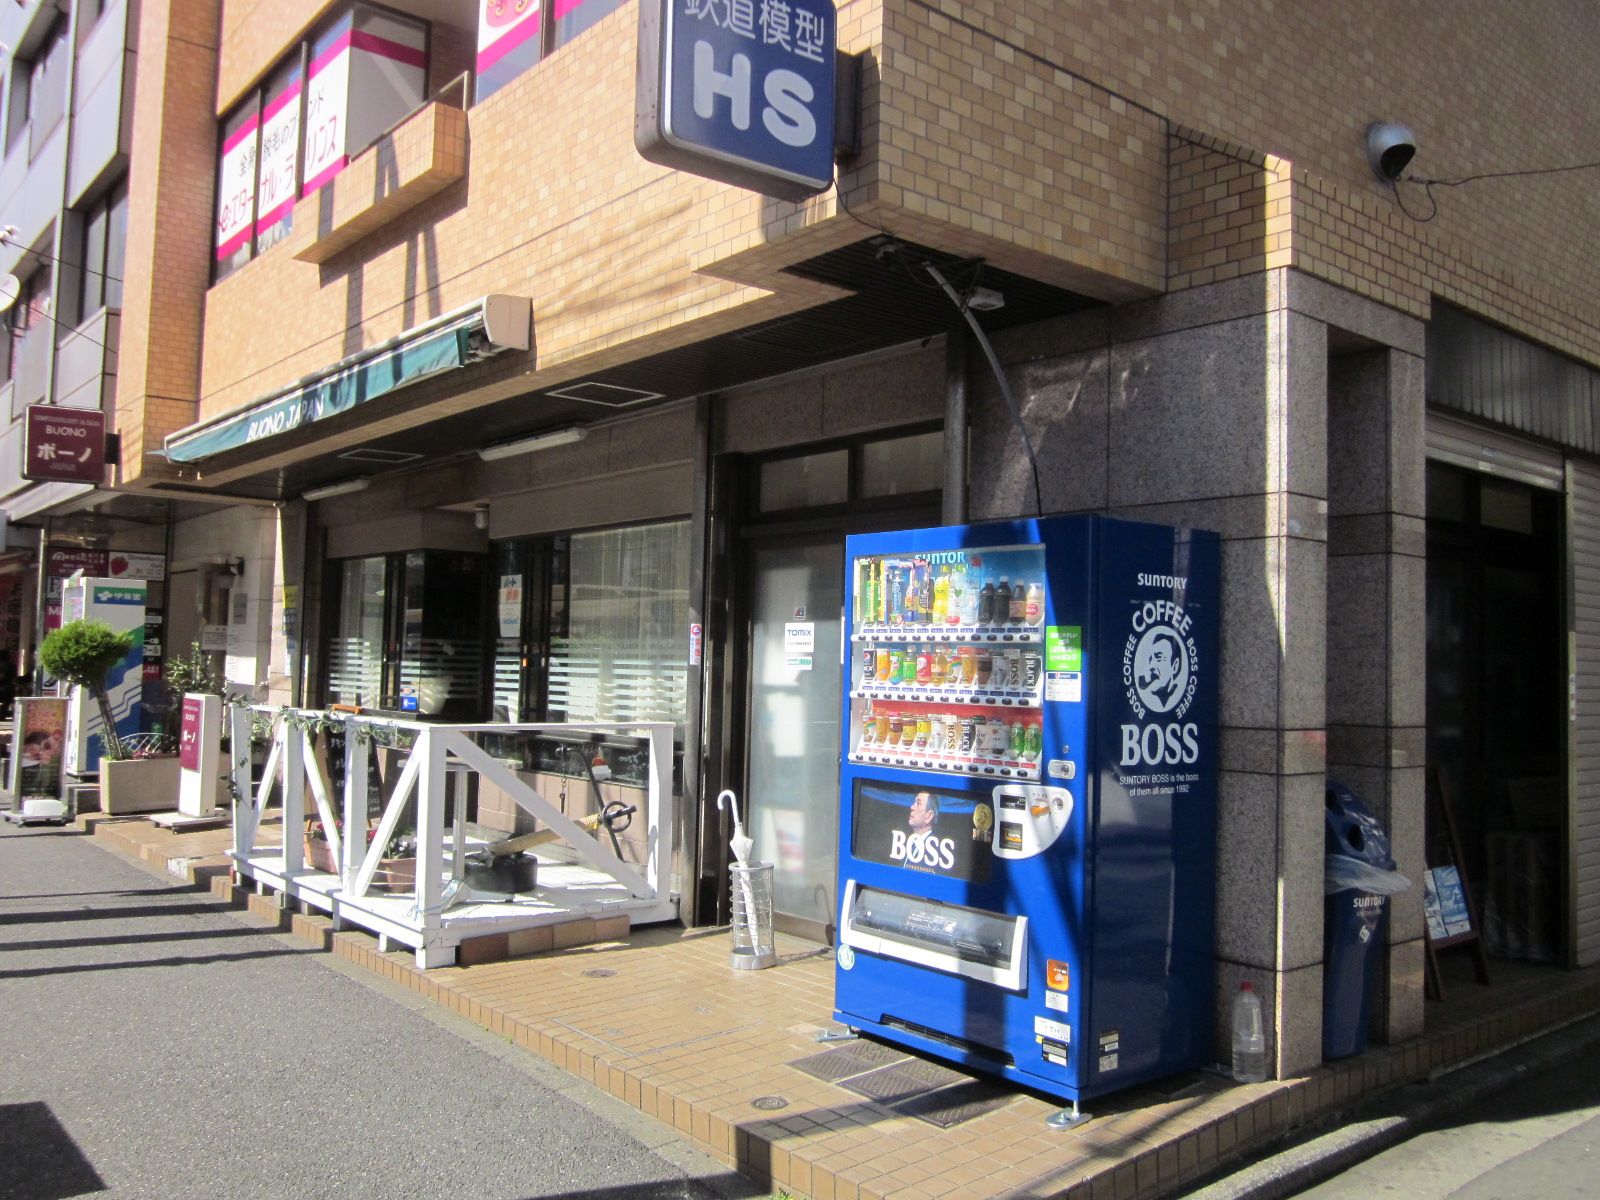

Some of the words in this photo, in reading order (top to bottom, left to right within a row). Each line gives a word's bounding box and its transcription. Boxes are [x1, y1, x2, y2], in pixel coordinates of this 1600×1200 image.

[693, 39, 817, 147] HS
[45, 424, 87, 438] BUONO
[246, 410, 285, 443] BUONO
[286, 393, 324, 429] JAPAN
[37, 442, 92, 463] ボーノ
[914, 551, 966, 565] SUNTOR
[1137, 572, 1188, 590] SUNTORY
[786, 629, 812, 637] TOMIX
[1132, 599, 1193, 637] COFFEE
[1123, 633, 1138, 686] COFFEE
[1186, 637, 1199, 672] BOSS
[1011, 658, 1019, 686] BOSS
[1126, 687, 1146, 720] BOSS
[1175, 675, 1198, 720] COFFEE
[947, 724, 955, 750] BOSS
[1120, 722, 1199, 766] BOSS
[1120, 775, 1151, 785] SUNTORY
[1151, 773, 1170, 784] BOSS
[1170, 774, 1176, 782] is
[1176, 773, 1185, 782] the
[1186, 772, 1199, 781] boss
[1130, 787, 1136, 797] of
[1136, 787, 1152, 796] them
[1160, 786, 1175, 794] since
[1176, 784, 1190, 793] 1992
[889, 829, 955, 870] BOSS
